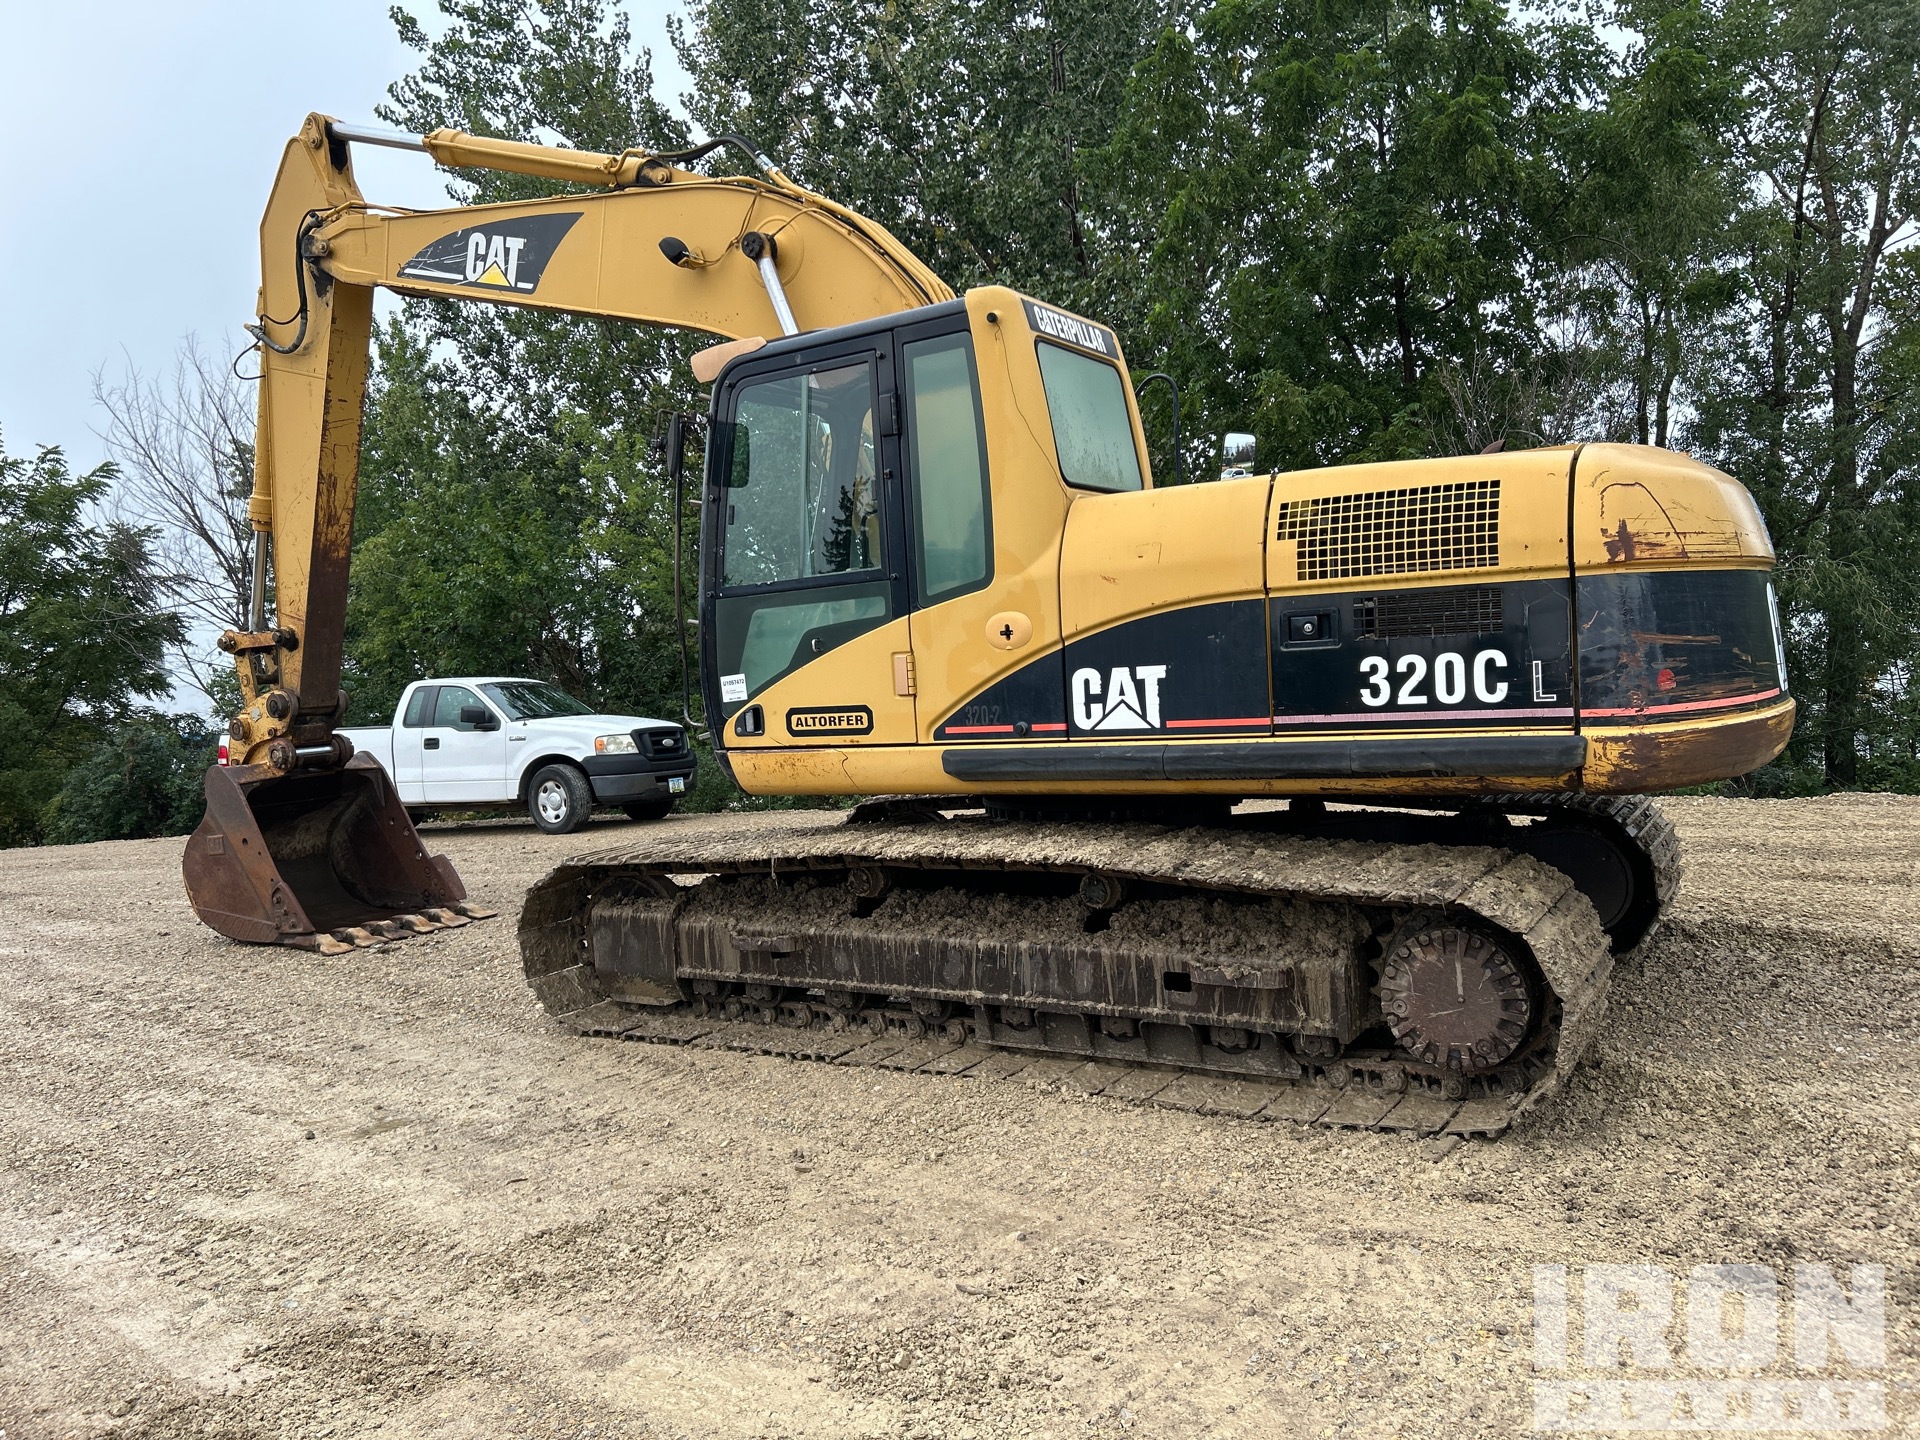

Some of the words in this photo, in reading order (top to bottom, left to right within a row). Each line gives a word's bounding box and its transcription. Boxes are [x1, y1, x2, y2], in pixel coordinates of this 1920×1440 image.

[465, 232, 526, 287] CAT
[1033, 305, 1107, 353] CATERPILLAR
[1072, 665, 1167, 730] CAT
[1359, 649, 1508, 706] 320C
[1532, 660, 1557, 701] L
[795, 715, 865, 728] ALTORFER
